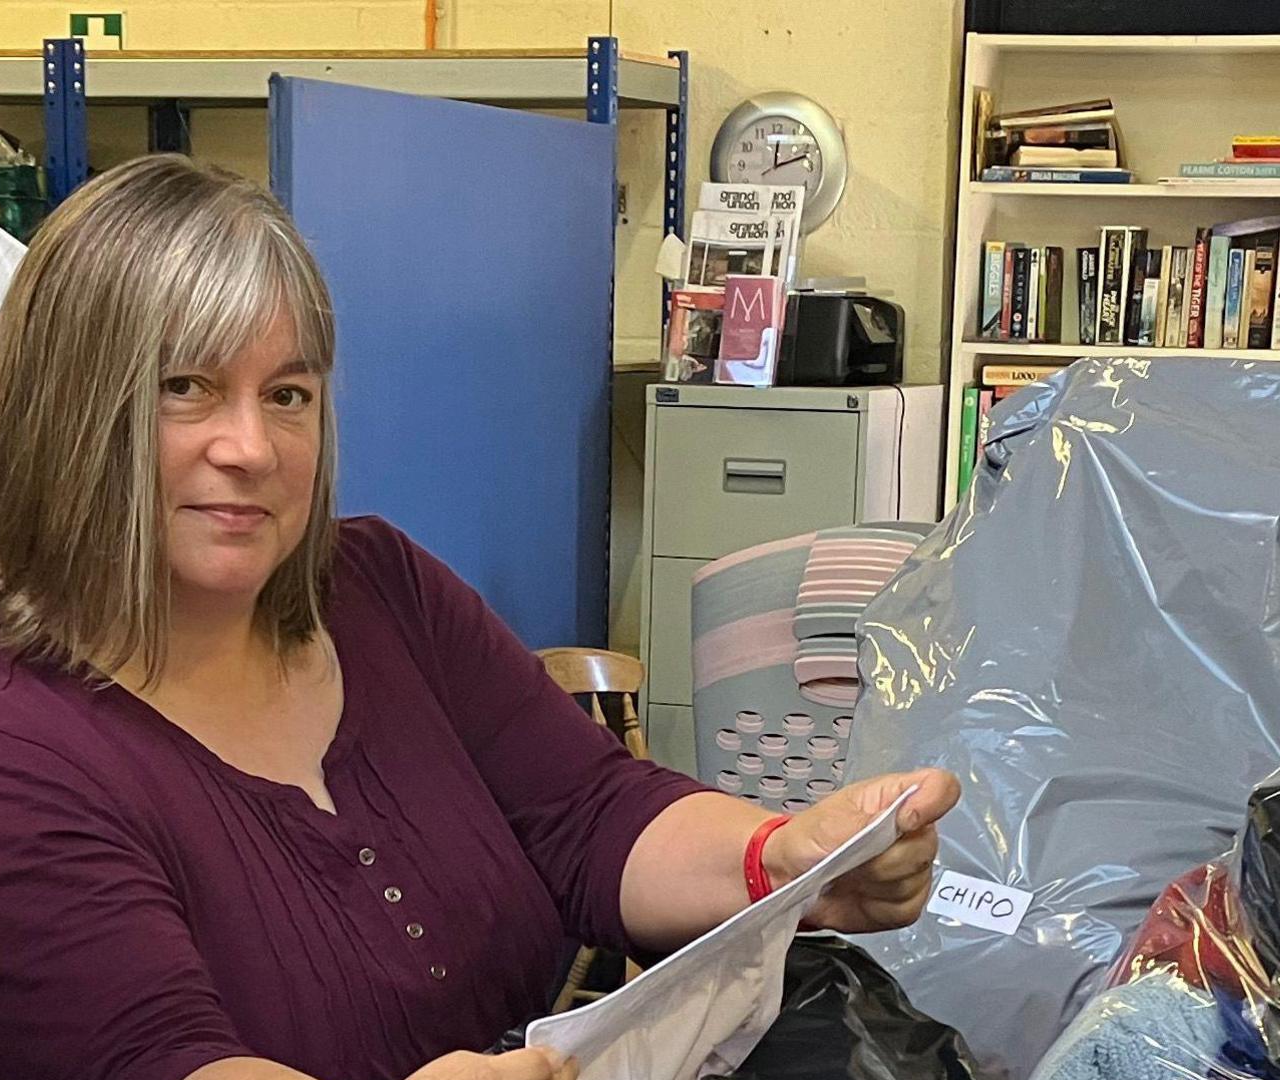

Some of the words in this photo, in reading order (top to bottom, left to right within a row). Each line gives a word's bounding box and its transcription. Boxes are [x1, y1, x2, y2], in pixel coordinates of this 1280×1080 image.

[754, 127, 765, 140] 11
[741, 140, 754, 154] 10
[736, 159, 746, 172] 9
[719, 190, 757, 204] grand
[727, 200, 760, 211] union
[728, 221, 766, 235] grand
[736, 229, 769, 240] union
[988, 252, 1001, 297] BIGGLES
[1189, 287, 1202, 318] TIGER
[938, 885, 1014, 918] CHIPO
